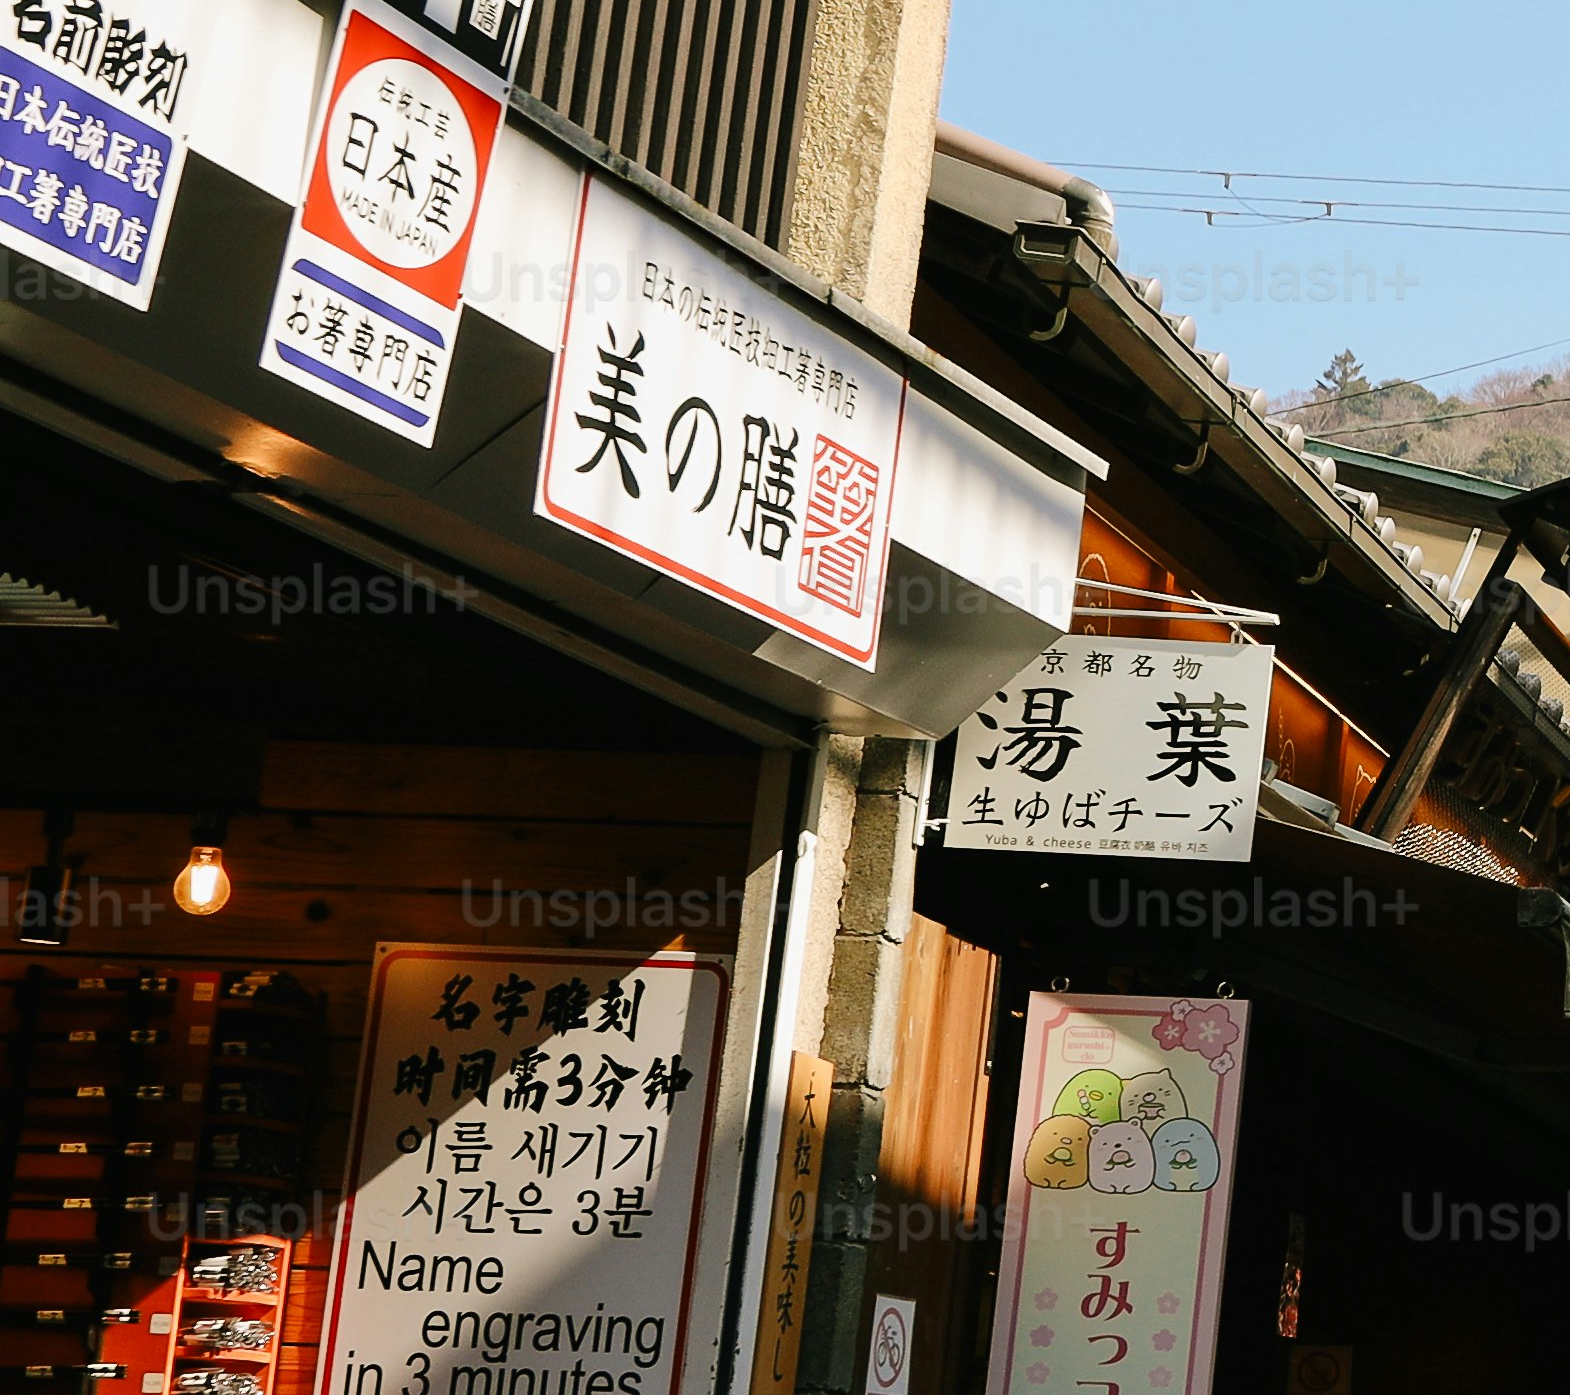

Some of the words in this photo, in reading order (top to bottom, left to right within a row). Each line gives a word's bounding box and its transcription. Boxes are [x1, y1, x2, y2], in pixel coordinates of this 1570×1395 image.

[0, 73, 165, 200] 日本伝統匠技
[376, 74, 452, 142] 伝統工芸
[340, 111, 462, 235] 日本産
[0, 153, 149, 266] 工箸専門店
[339, 186, 379, 230] MADE
[380, 211, 395, 236] IN
[394, 215, 439, 259] JAPAN
[284, 290, 439, 404] お箸専門店
[642, 260, 860, 421] 日本の伝統匠技細工箸専門店
[573, 320, 800, 562] 美の膳
[1040, 649, 1205, 682] 京都名物
[974, 685, 1250, 789] 湯葉
[960, 785, 1245, 838] 生ゆばチーズ
[985, 833, 1018, 847] Yuba
[1026, 836, 1036, 847] &
[1043, 836, 1092, 850] cheese
[430, 973, 646, 1041] 名字雕刻
[392, 1051, 695, 1116] 时间需3分钟
[396, 1120, 494, 1175] 이름
[512, 1122, 661, 1183] 새기기
[400, 1178, 553, 1238] 시간은
[576, 1184, 655, 1240] 3분
[357, 1239, 505, 1296] Name
[421, 1308, 666, 1370] engraving
